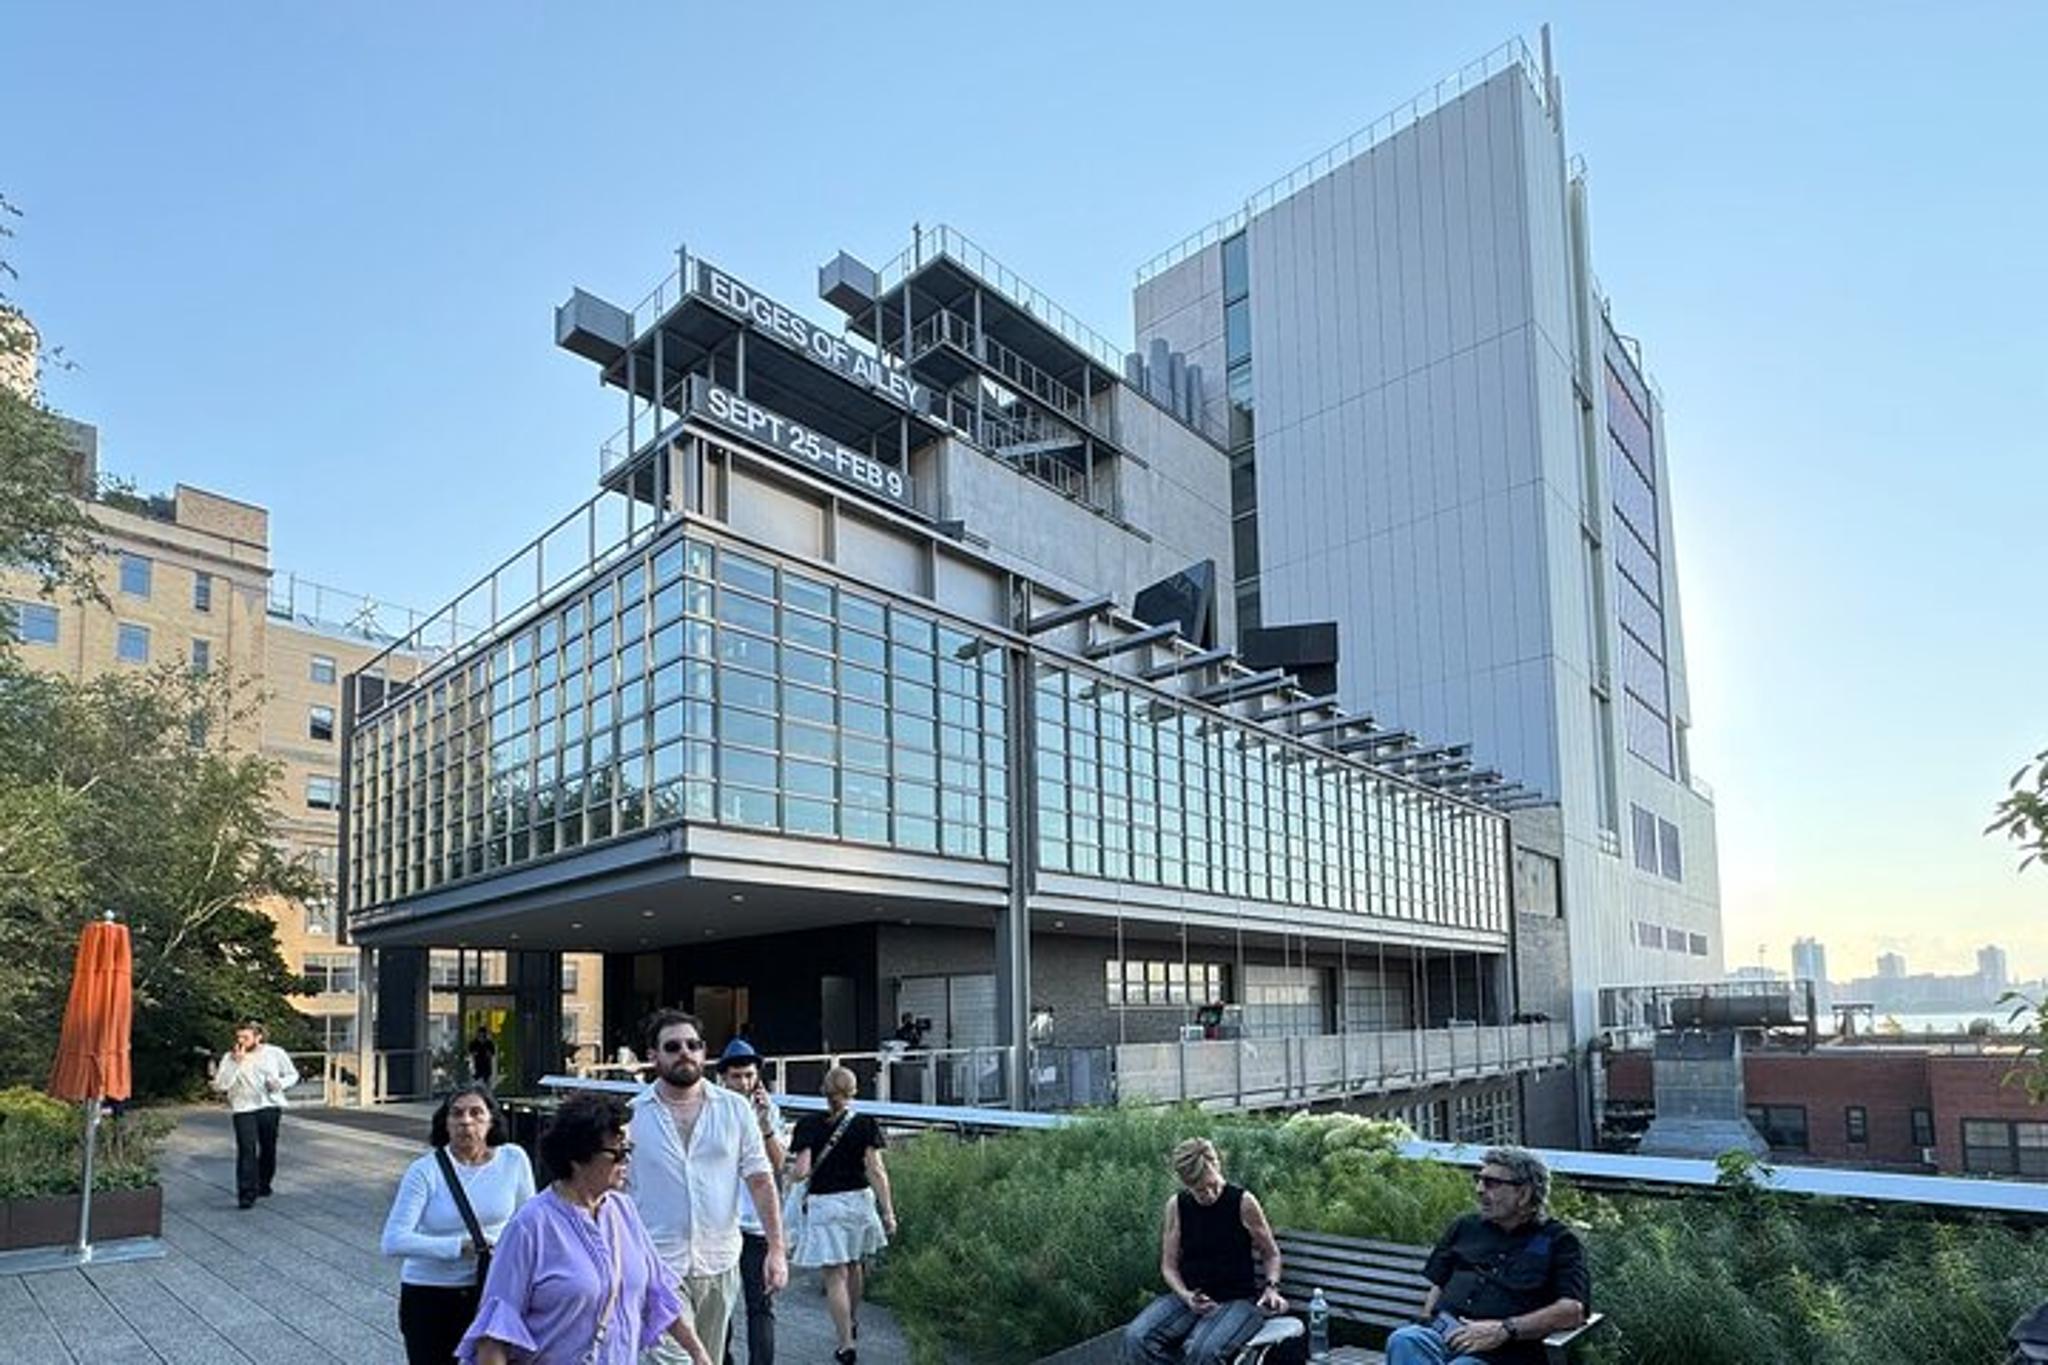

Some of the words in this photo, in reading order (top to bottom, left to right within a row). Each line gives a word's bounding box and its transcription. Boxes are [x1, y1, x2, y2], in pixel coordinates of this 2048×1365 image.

[710, 270, 809, 347] EDGES
[812, 331, 848, 366] OF
[853, 359, 919, 406] AILEY
[707, 387, 783, 443] SEPT
[886, 472, 902, 498] 9
